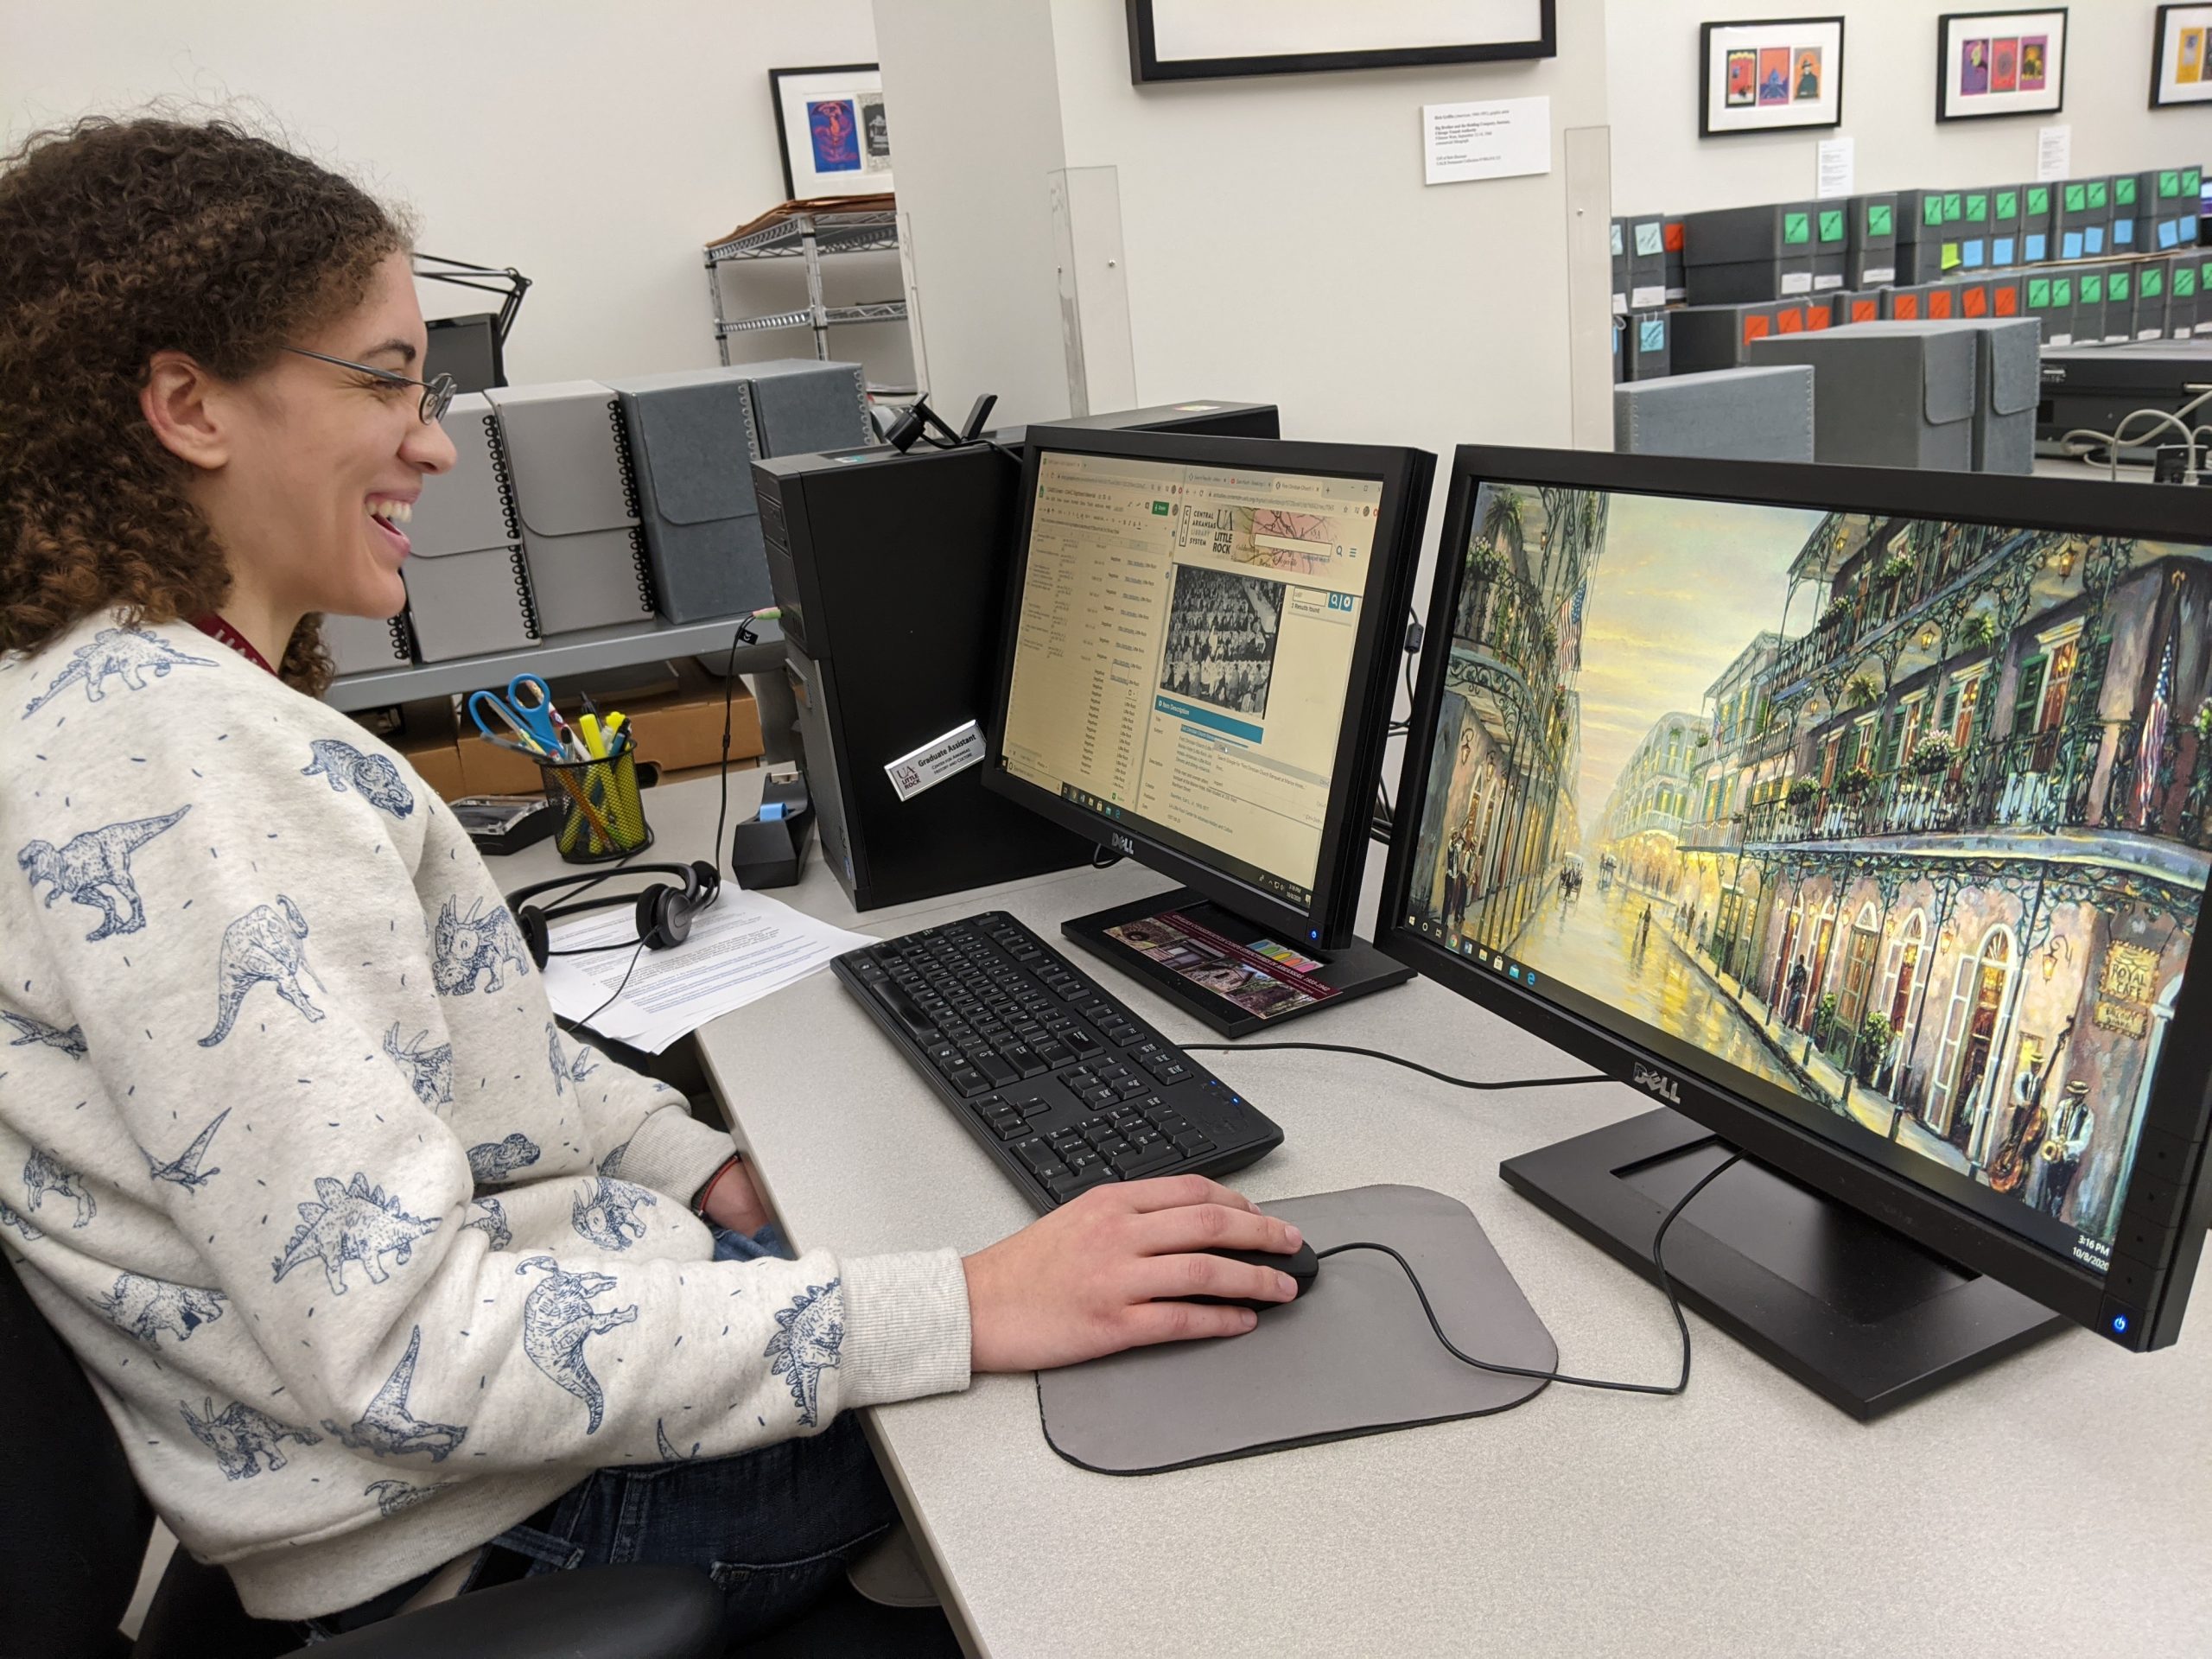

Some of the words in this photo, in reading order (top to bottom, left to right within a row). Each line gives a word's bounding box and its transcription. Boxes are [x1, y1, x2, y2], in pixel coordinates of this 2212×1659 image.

[1193, 511, 1214, 519] CENTRAL
[1217, 509, 1233, 531] UA
[1192, 519, 1217, 529] ARKANSAS
[1189, 537, 1206, 546] SYSTEM
[1214, 531, 1233, 543] LITTLE
[1212, 543, 1231, 554] ROCK
[918, 748, 948, 767] Graduate
[947, 734, 976, 753] Assistant
[897, 766, 916, 779] UA
[901, 772, 919, 785] LITTLE
[904, 779, 921, 790] ROCK
[1111, 832, 1134, 855] DELL
[2112, 963, 2146, 988] ROYAL
[2116, 982, 2142, 1002] CAFE
[1633, 1062, 1681, 1104] DELL
[2077, 1235, 2094, 1249] 3:16
[2094, 1243, 2110, 1256] PM
[2073, 1246, 2109, 1271] 10/8/2020
